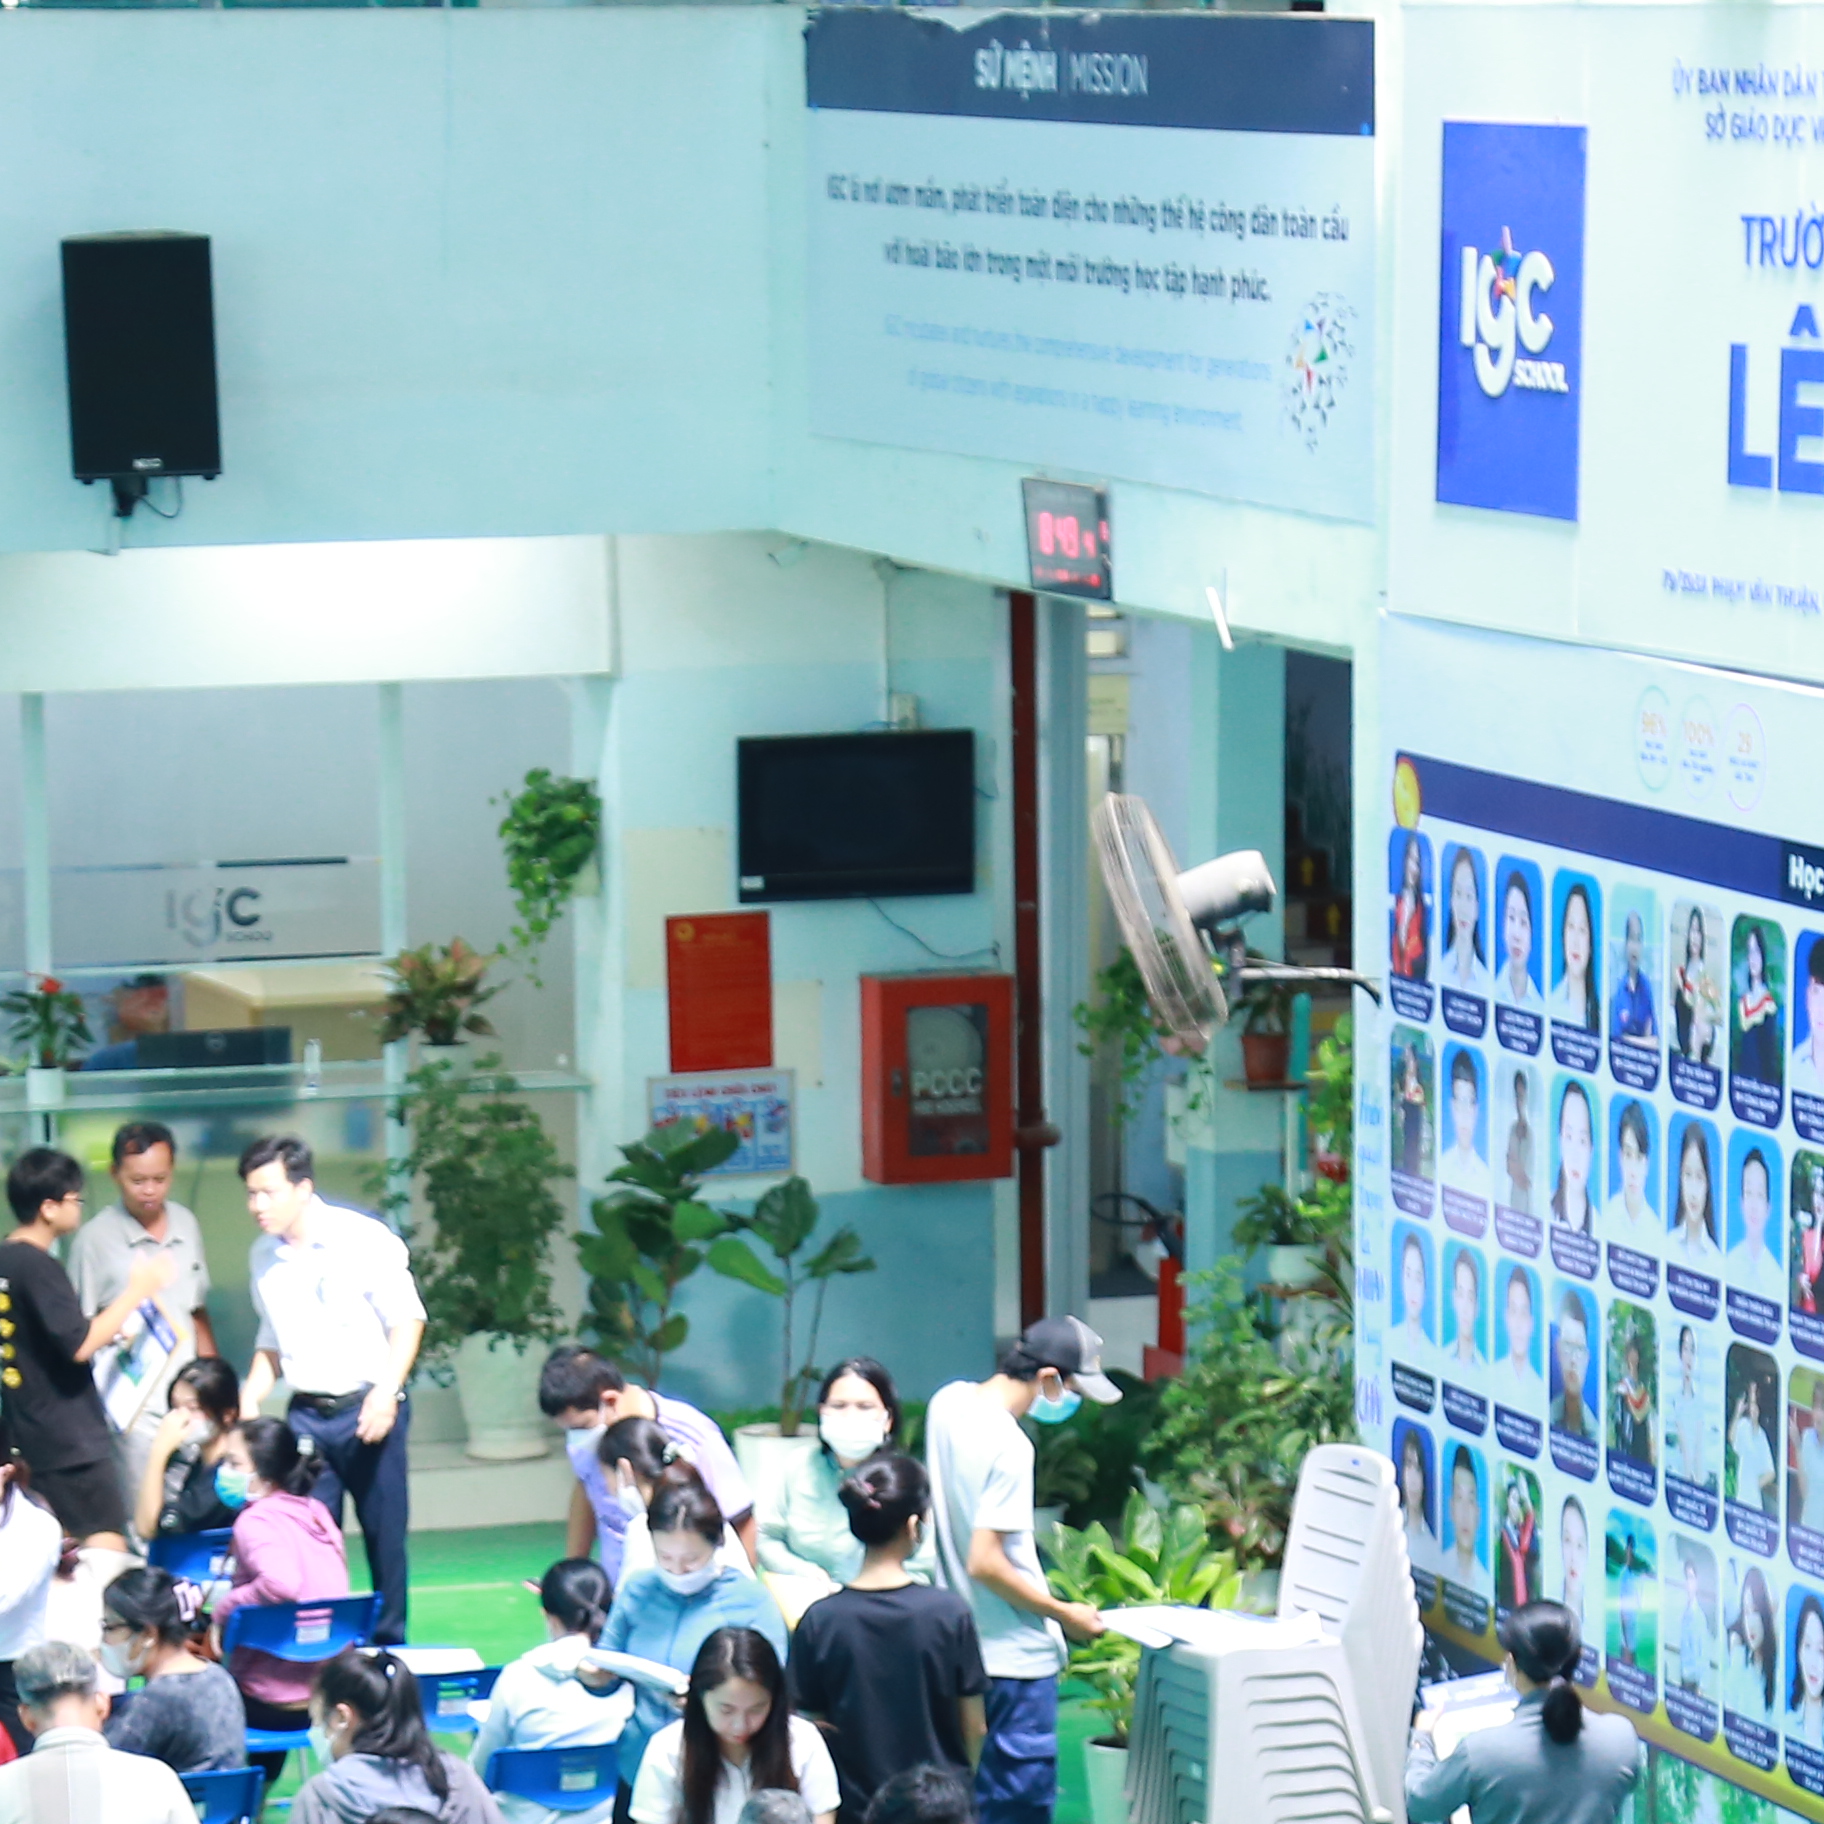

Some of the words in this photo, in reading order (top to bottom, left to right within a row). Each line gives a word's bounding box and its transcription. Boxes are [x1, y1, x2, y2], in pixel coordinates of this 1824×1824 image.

[1070, 52, 1149, 96] MISSION
[1698, 67, 1729, 96] BAN
[1735, 62, 1778, 98] NHÂN
[1731, 107, 1769, 143] GIÁO
[1513, 358, 1570, 394] SCHOOL
[1789, 855, 1824, 900] Học
[913, 1067, 983, 1097] PCCC
